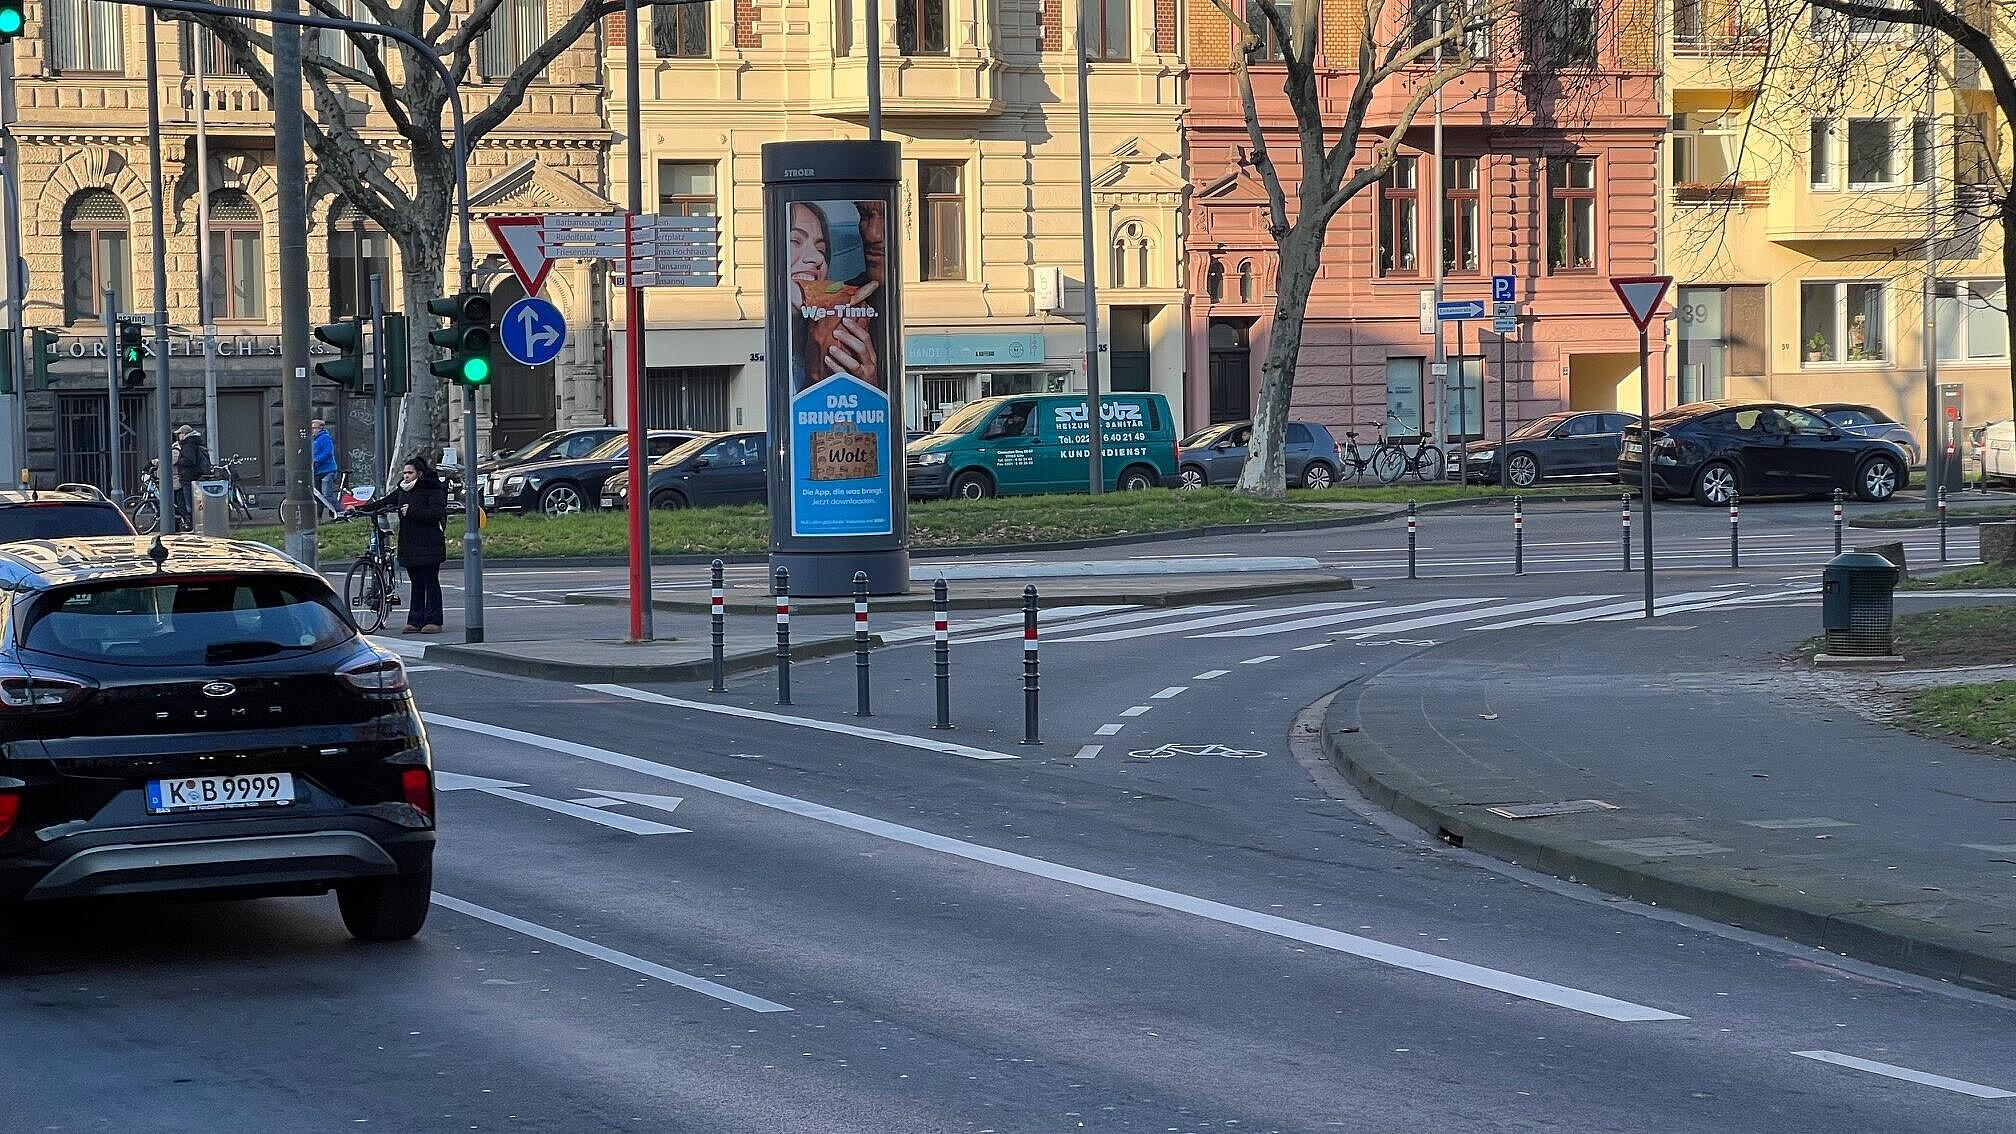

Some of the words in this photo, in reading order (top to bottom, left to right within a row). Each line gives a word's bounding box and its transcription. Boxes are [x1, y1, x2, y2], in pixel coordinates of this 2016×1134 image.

[555, 218, 612, 226] Barbarossaplatz
[556, 232, 597, 241] Rudolfplatz
[657, 232, 685, 241] ertplatz
[556, 247, 599, 256] Friesenplatz
[672, 247, 707, 256] Hochhaus
[801, 303, 879, 319] We-Time.
[1681, 304, 1708, 324] 39
[1098, 343, 1108, 353] 35
[749, 353, 765, 362] 35a
[826, 394, 858, 409] DAS
[798, 410, 853, 425] BRINGT
[856, 410, 885, 424] NUR
[1056, 422, 1090, 430] HEIZUN
[1105, 419, 1144, 428] SANITÄR
[1058, 435, 1074, 444] Tel.
[828, 447, 868, 463] Wolt
[802, 488, 814, 496] Die
[812, 498, 829, 506] Jetzt
[156, 706, 282, 719] PUMA
[169, 782, 186, 804] K
[201, 779, 218, 802] B
[222, 776, 280, 800] 9999
